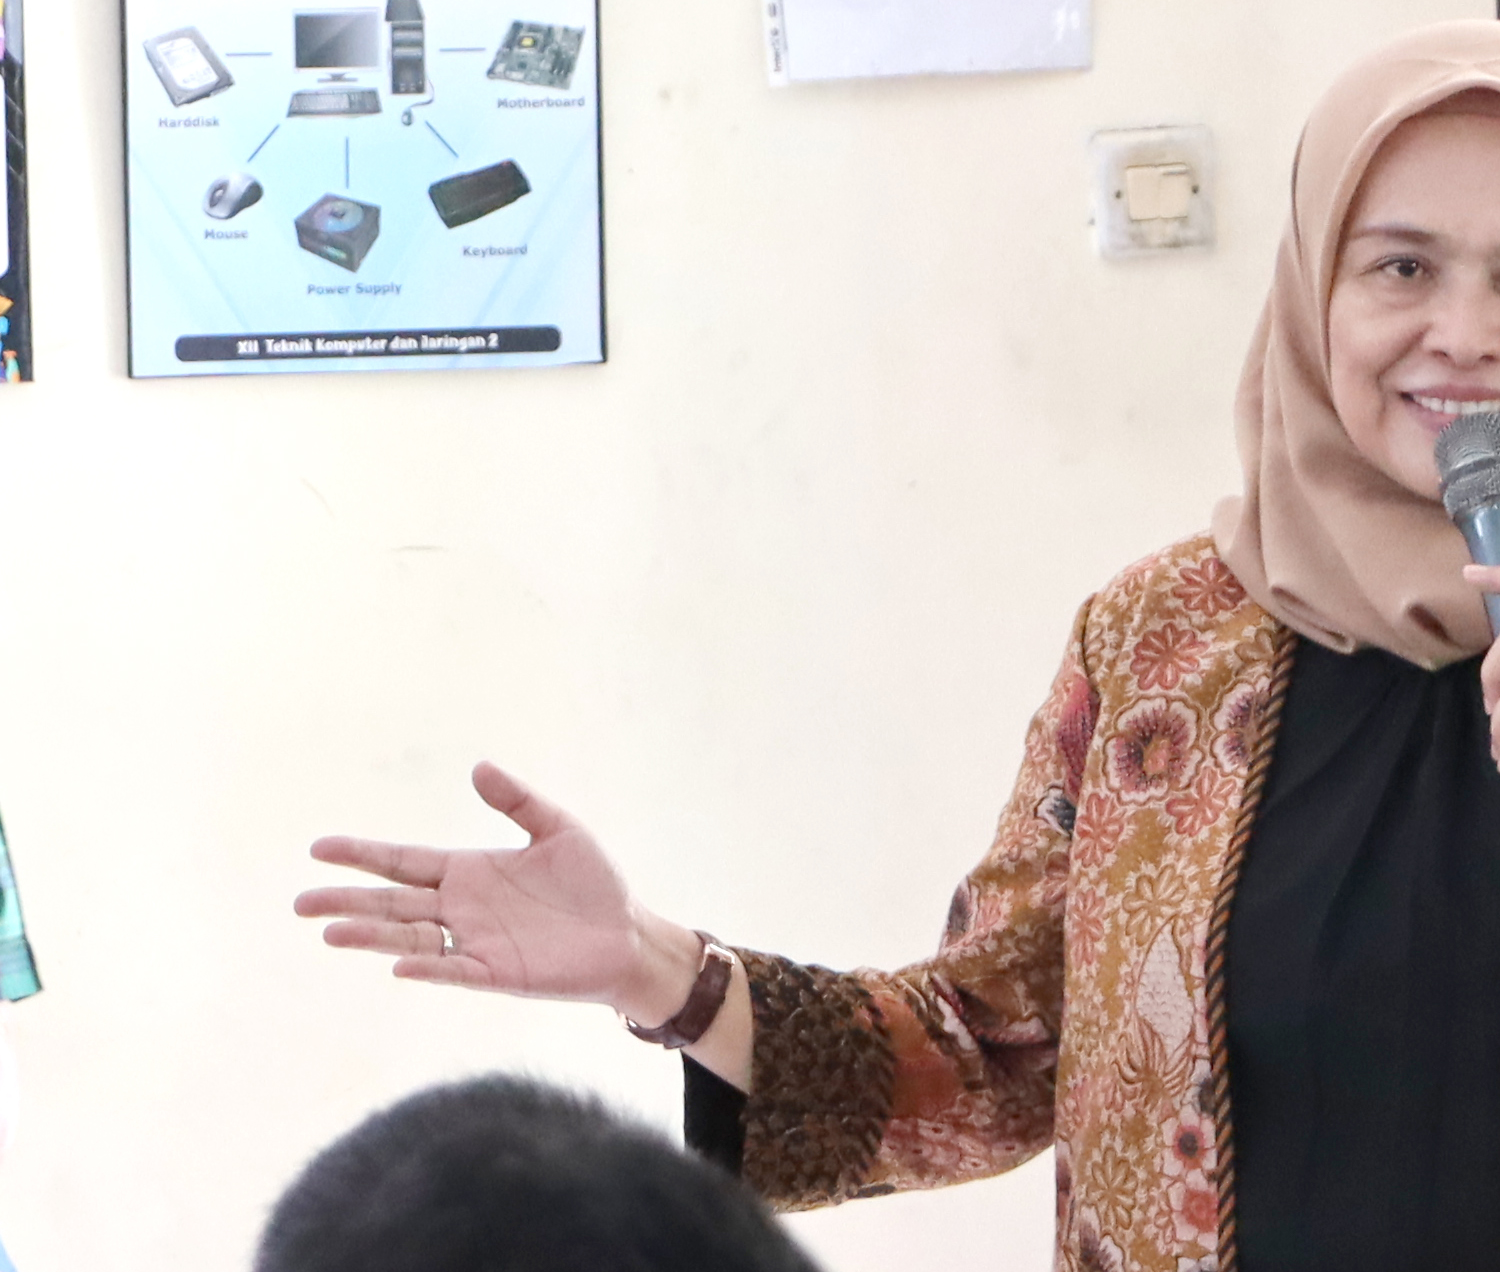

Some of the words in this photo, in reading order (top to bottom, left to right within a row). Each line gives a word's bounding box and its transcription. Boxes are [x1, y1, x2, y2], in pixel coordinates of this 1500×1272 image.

[496, 96, 585, 109] Motherboard
[158, 116, 220, 128] Harddisk
[205, 228, 249, 240] Mouse
[463, 244, 528, 259] Keyboard
[307, 283, 350, 295] Power
[355, 282, 402, 297] Supply
[237, 340, 259, 355] XII
[265, 338, 314, 354] Teknik
[315, 337, 388, 355] Komputer
[391, 336, 419, 351] dan
[421, 335, 487, 352] Jaringan
[488, 333, 499, 348] 2
